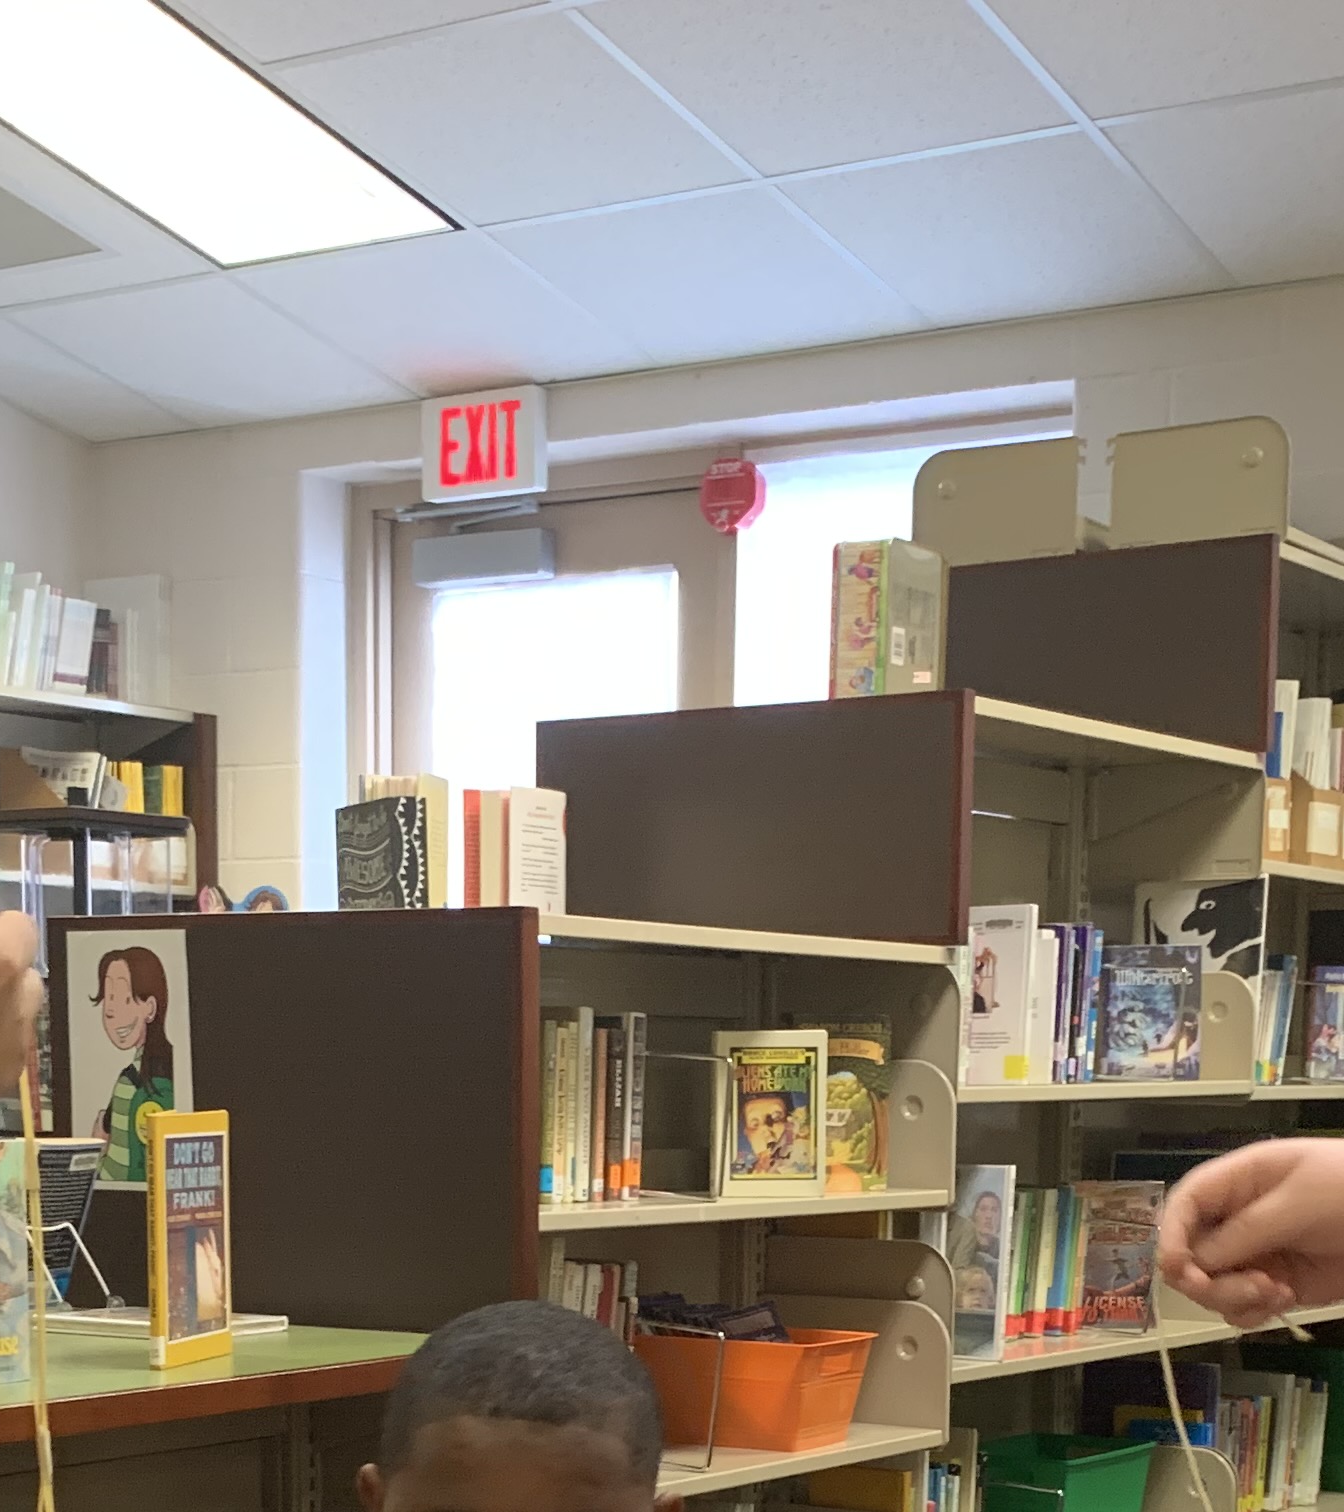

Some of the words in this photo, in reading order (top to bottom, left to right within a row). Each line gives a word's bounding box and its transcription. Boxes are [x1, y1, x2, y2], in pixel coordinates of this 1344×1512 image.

[440, 399, 522, 487] EXIT
[710, 461, 742, 475] STOP
[201, 1141, 215, 1162] GO
[173, 1189, 215, 1210] FRANK!
[1084, 1295, 1145, 1310] LICENSE
